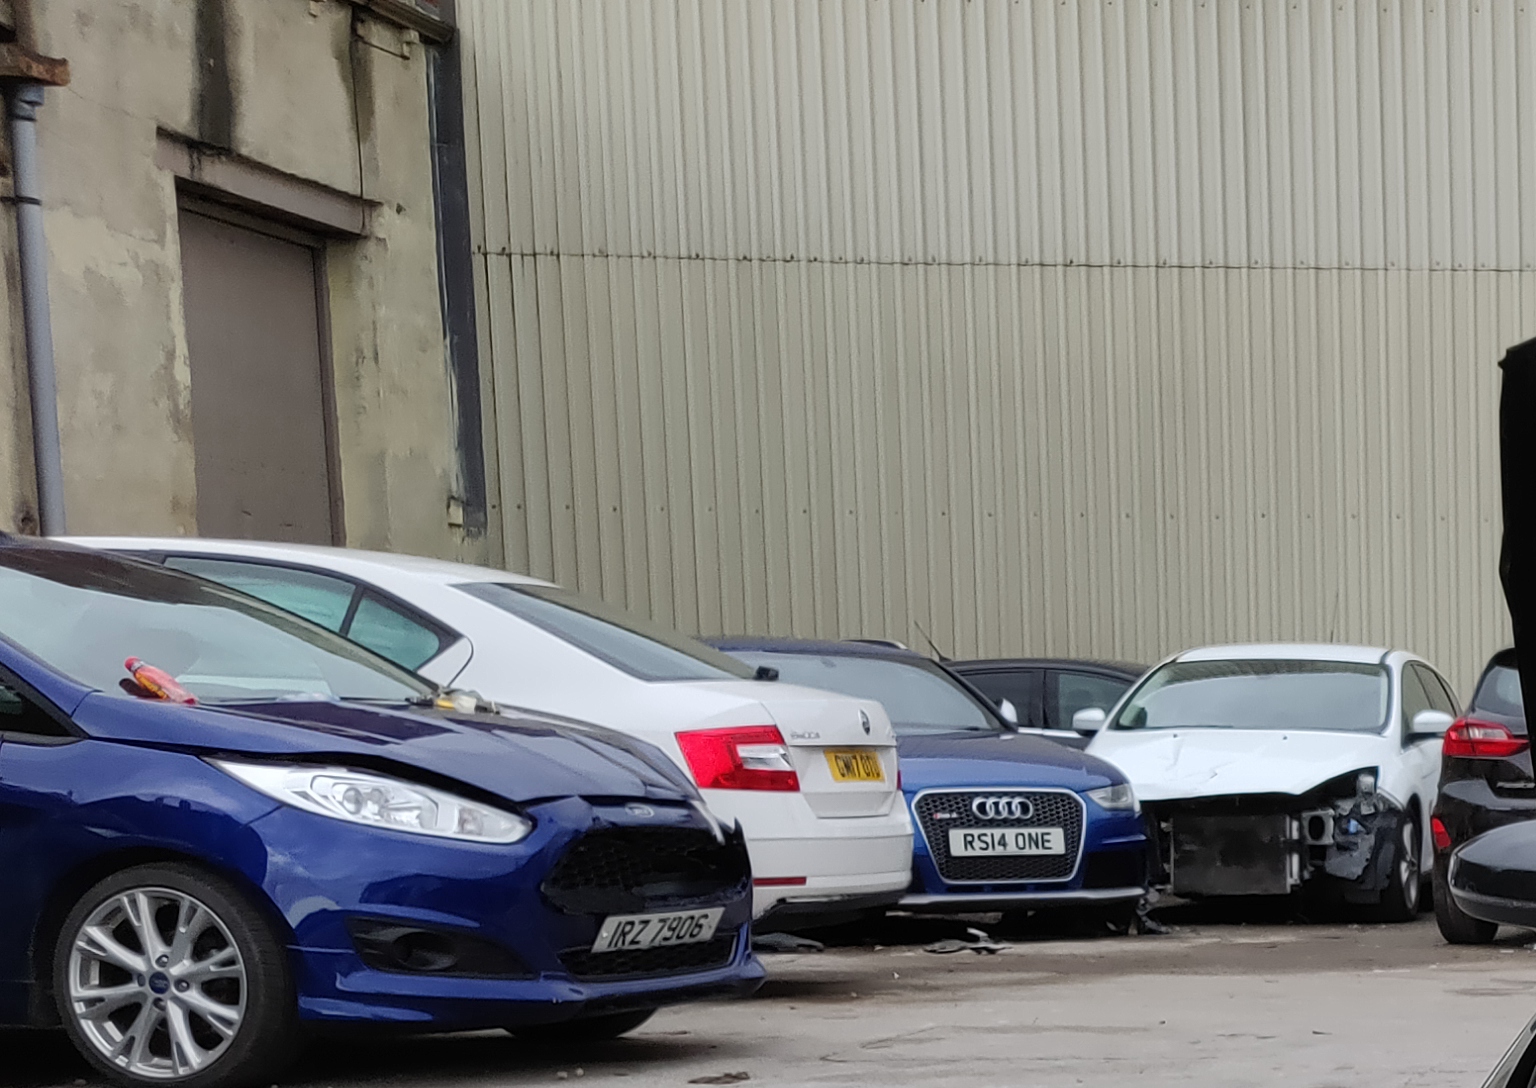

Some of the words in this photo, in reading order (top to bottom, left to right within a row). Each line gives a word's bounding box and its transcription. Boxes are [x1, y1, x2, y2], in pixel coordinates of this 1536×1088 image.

[963, 832, 1008, 851] RS14
[1014, 832, 1054, 851] ONE
[607, 919, 652, 948] IRZ
[648, 913, 709, 945] 7906
